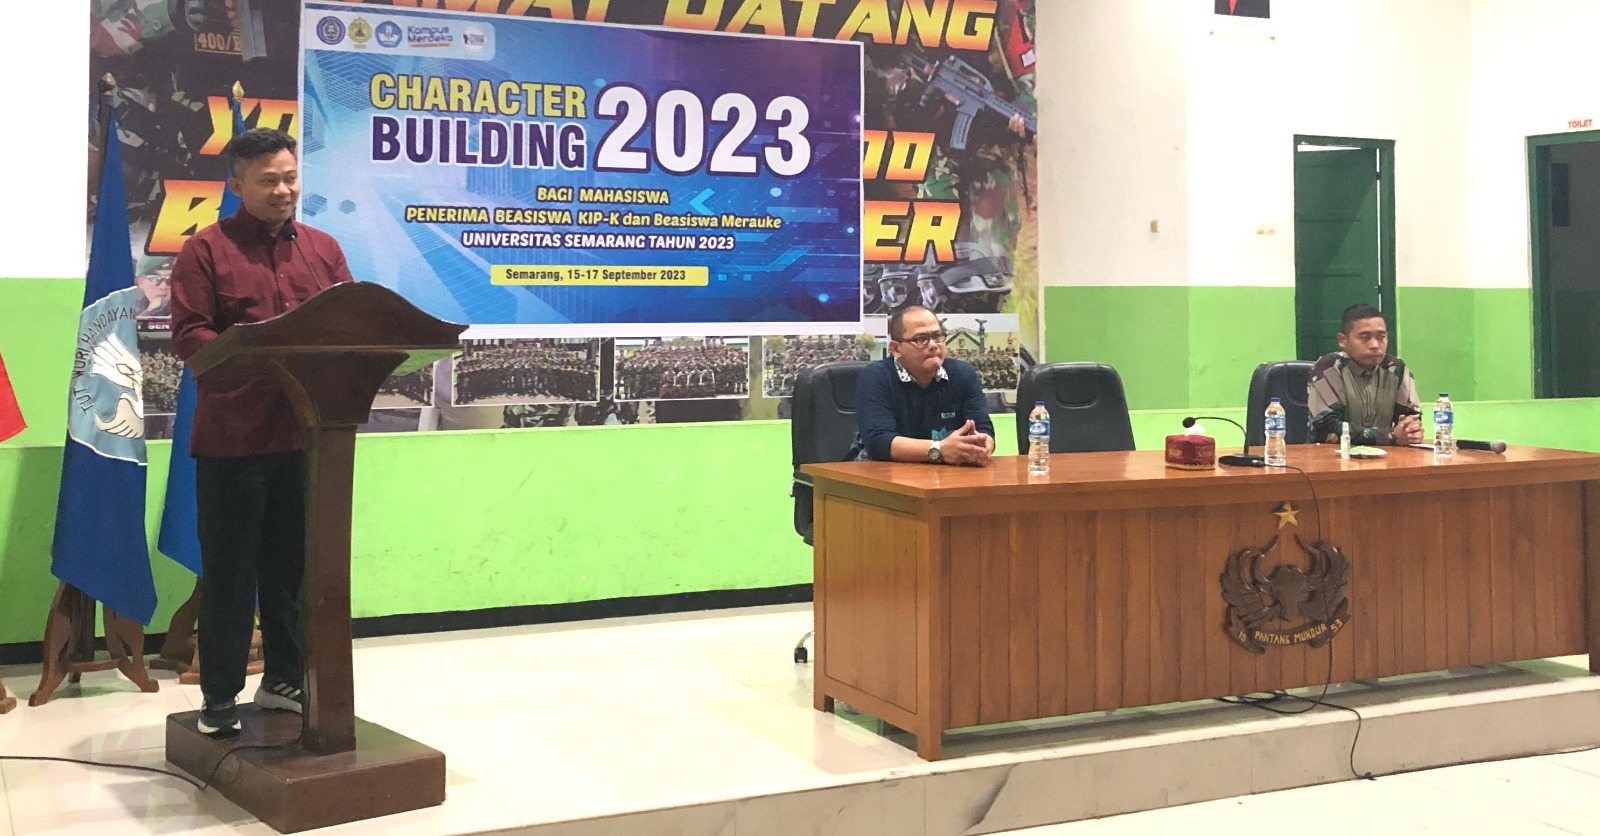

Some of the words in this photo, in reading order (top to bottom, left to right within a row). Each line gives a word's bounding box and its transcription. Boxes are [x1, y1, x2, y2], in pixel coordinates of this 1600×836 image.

[370, 73, 587, 118] CHARACTER
[596, 84, 812, 178] 2023
[1567, 119, 1593, 129] TOILET
[371, 115, 585, 169] BUILDING
[537, 187, 573, 202] BAGI
[580, 188, 669, 204] MAHASISWA
[406, 207, 489, 223] PENERIMA
[495, 209, 572, 225] BEASISWA
[578, 211, 620, 226] KIP-K
[622, 212, 650, 226] dan
[654, 213, 719, 228] Beasiswa
[721, 214, 782, 229] Merauke
[864, 200, 961, 262] ER
[463, 232, 561, 247] UNIVERSITAS
[565, 234, 645, 249] SEMARANG
[650, 235, 696, 249] TAHUN
[699, 236, 735, 250] 2023
[506, 268, 564, 282] Semarang,
[567, 269, 599, 280] 15-17
[602, 269, 657, 283] September
[660, 270, 686, 281] 2023
[81, 306, 137, 347] HANDAYAN
[72, 347, 91, 379] WURI
[73, 387, 94, 415] TUT
[1254, 630, 1291, 645] PANTANG
[1294, 623, 1327, 643] MUNDUR
[1330, 618, 1343, 633] 53
